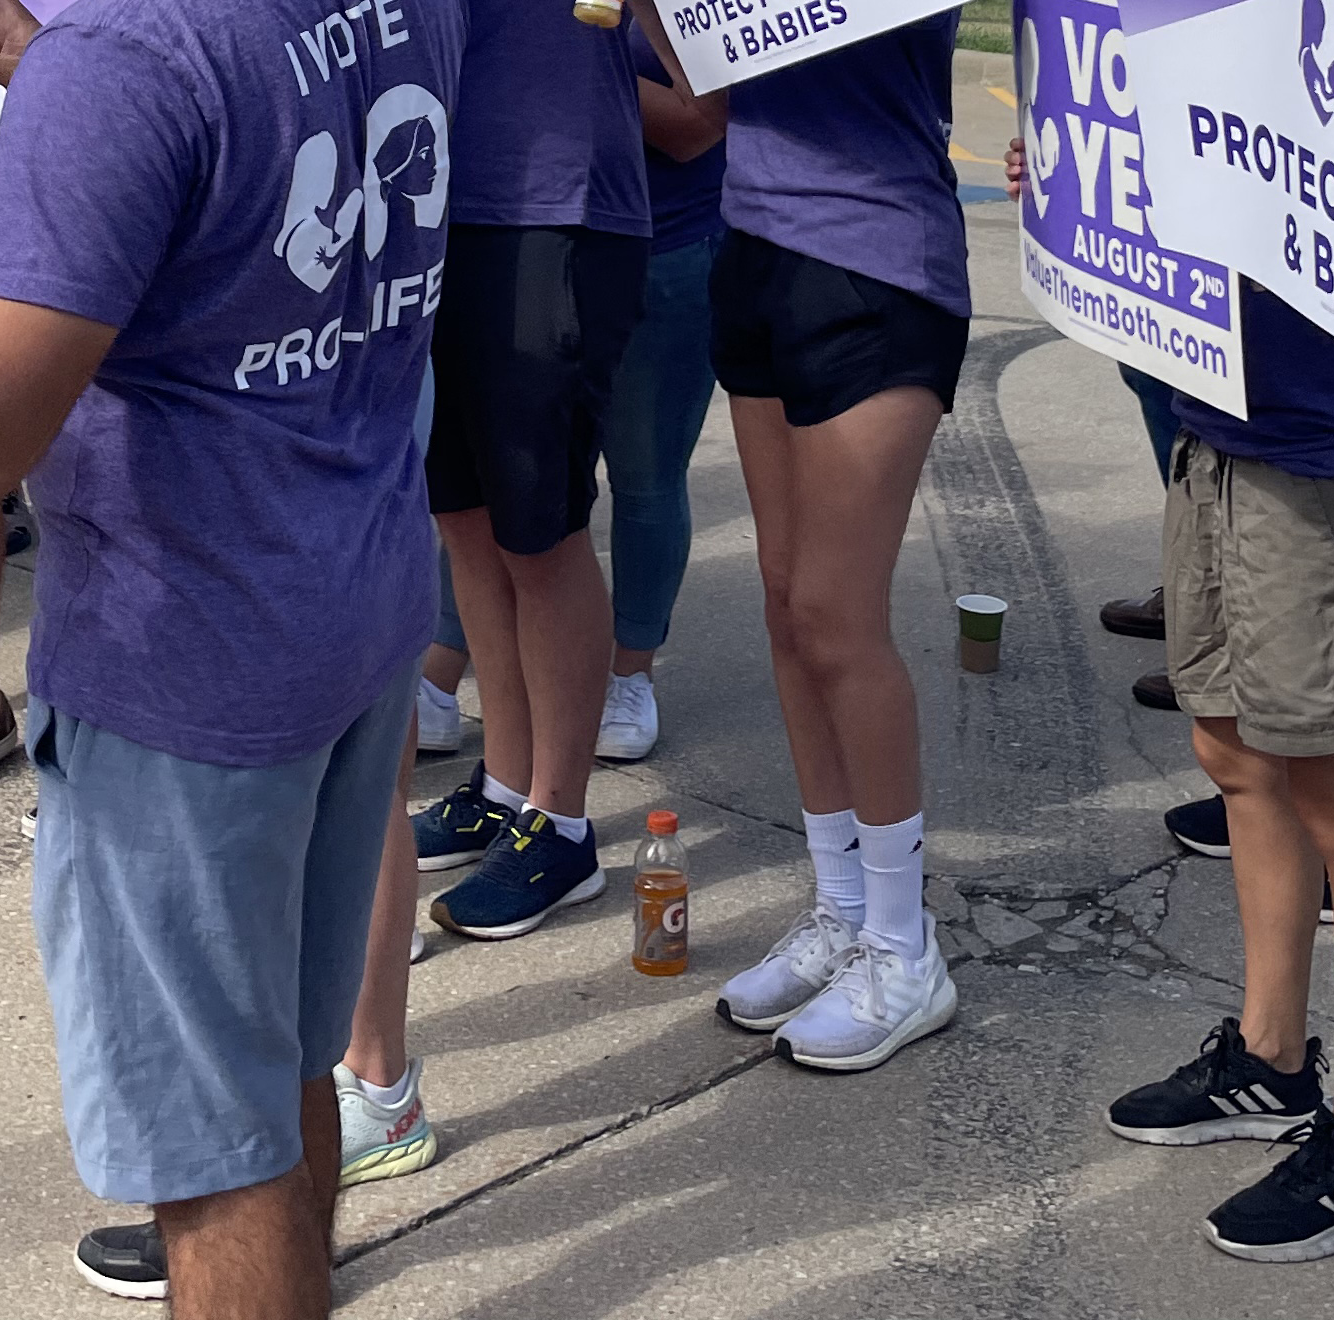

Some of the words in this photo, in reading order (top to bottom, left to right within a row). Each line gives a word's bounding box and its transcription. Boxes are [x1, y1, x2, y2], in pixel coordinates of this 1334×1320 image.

[285, 41, 310, 97] I
[724, 33, 739, 63] &
[1060, 15, 1136, 118] VO
[1065, 112, 1153, 238] YE
[1073, 224, 1178, 298] AUGUST
[1190, 268, 1225, 310] 2ND
[1283, 213, 1304, 277] &
[1023, 238, 1227, 378] ValueThemBoth.com
